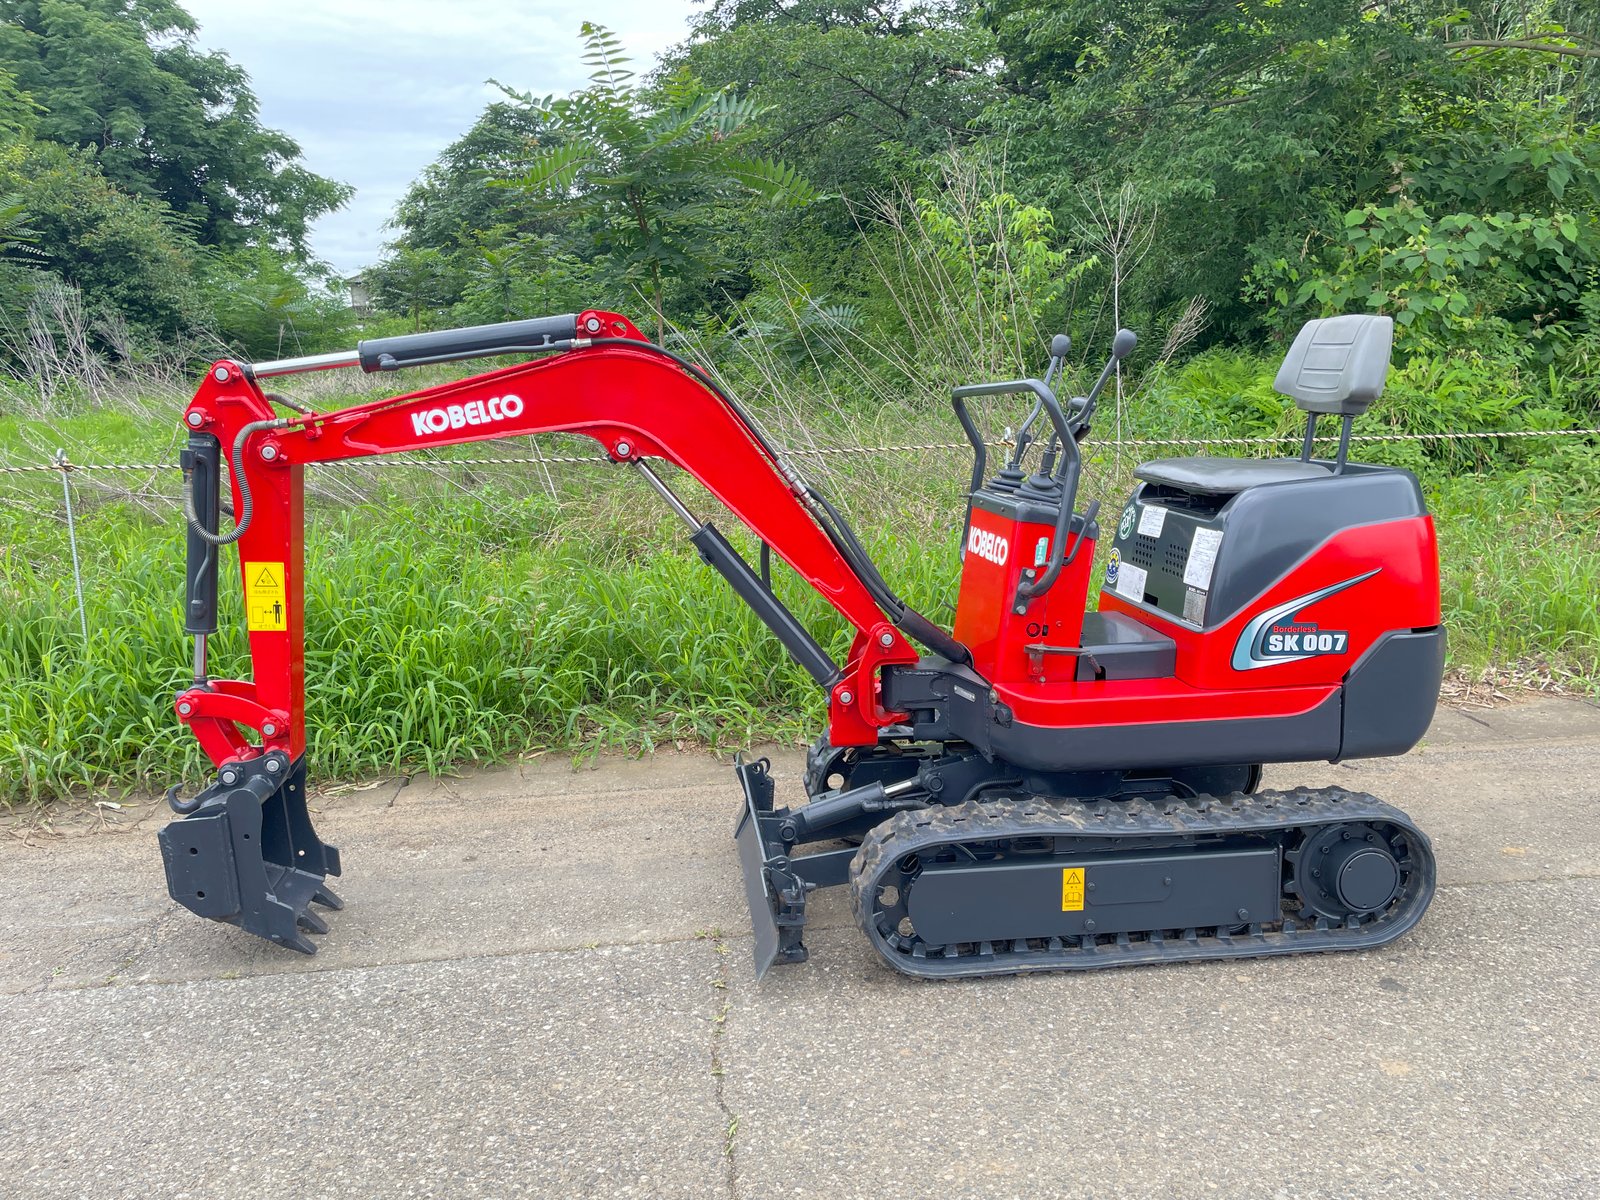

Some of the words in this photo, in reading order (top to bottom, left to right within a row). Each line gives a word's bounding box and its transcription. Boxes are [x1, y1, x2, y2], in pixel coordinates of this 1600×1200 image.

[411, 394, 524, 436] KOBELCO
[967, 525, 1008, 567] KOBELCO
[1268, 634, 1299, 652] SK
[1303, 634, 1346, 652] 007
[1273, 625, 1317, 633] Borderless
